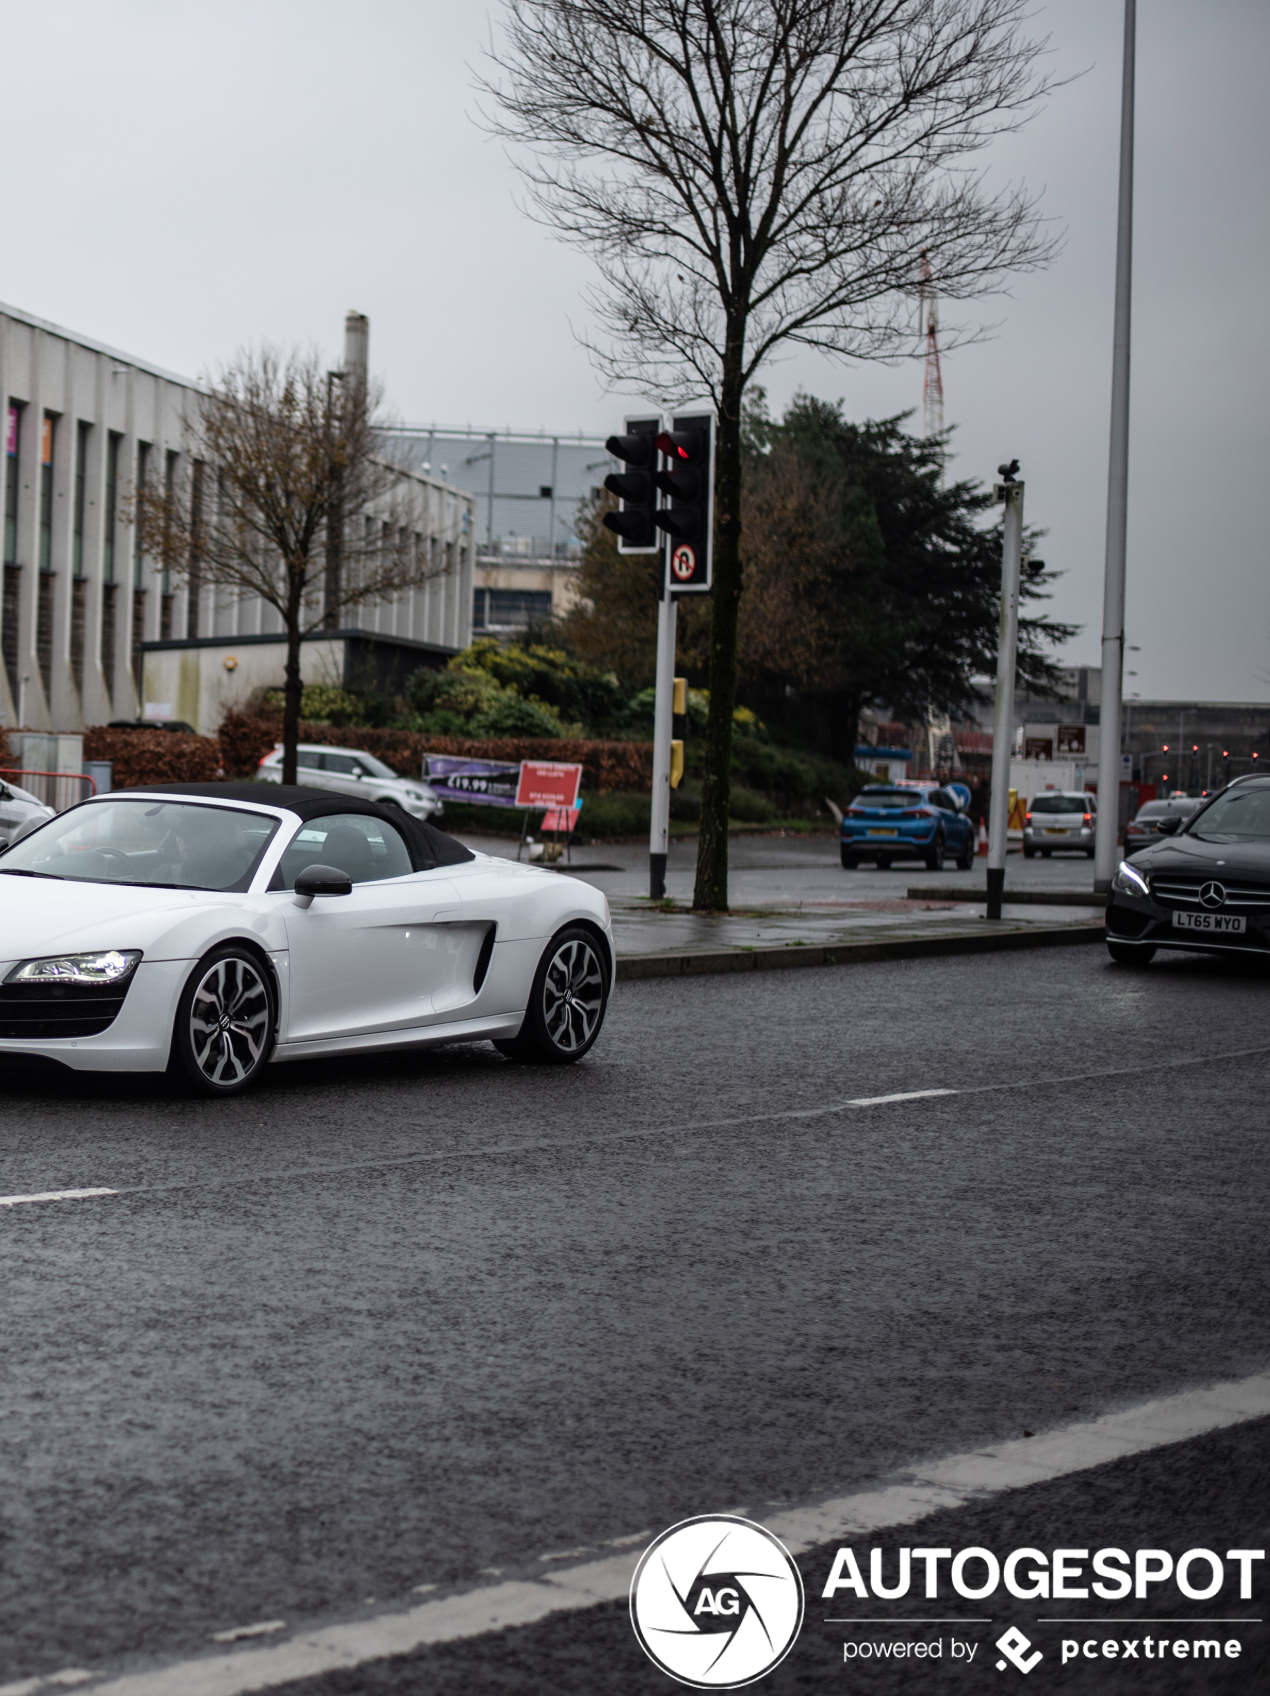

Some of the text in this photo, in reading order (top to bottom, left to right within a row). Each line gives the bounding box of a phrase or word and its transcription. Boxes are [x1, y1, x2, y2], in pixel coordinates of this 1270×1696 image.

[447, 775, 487, 791] £19.99
[1177, 913, 1241, 931] LT65 WYO
